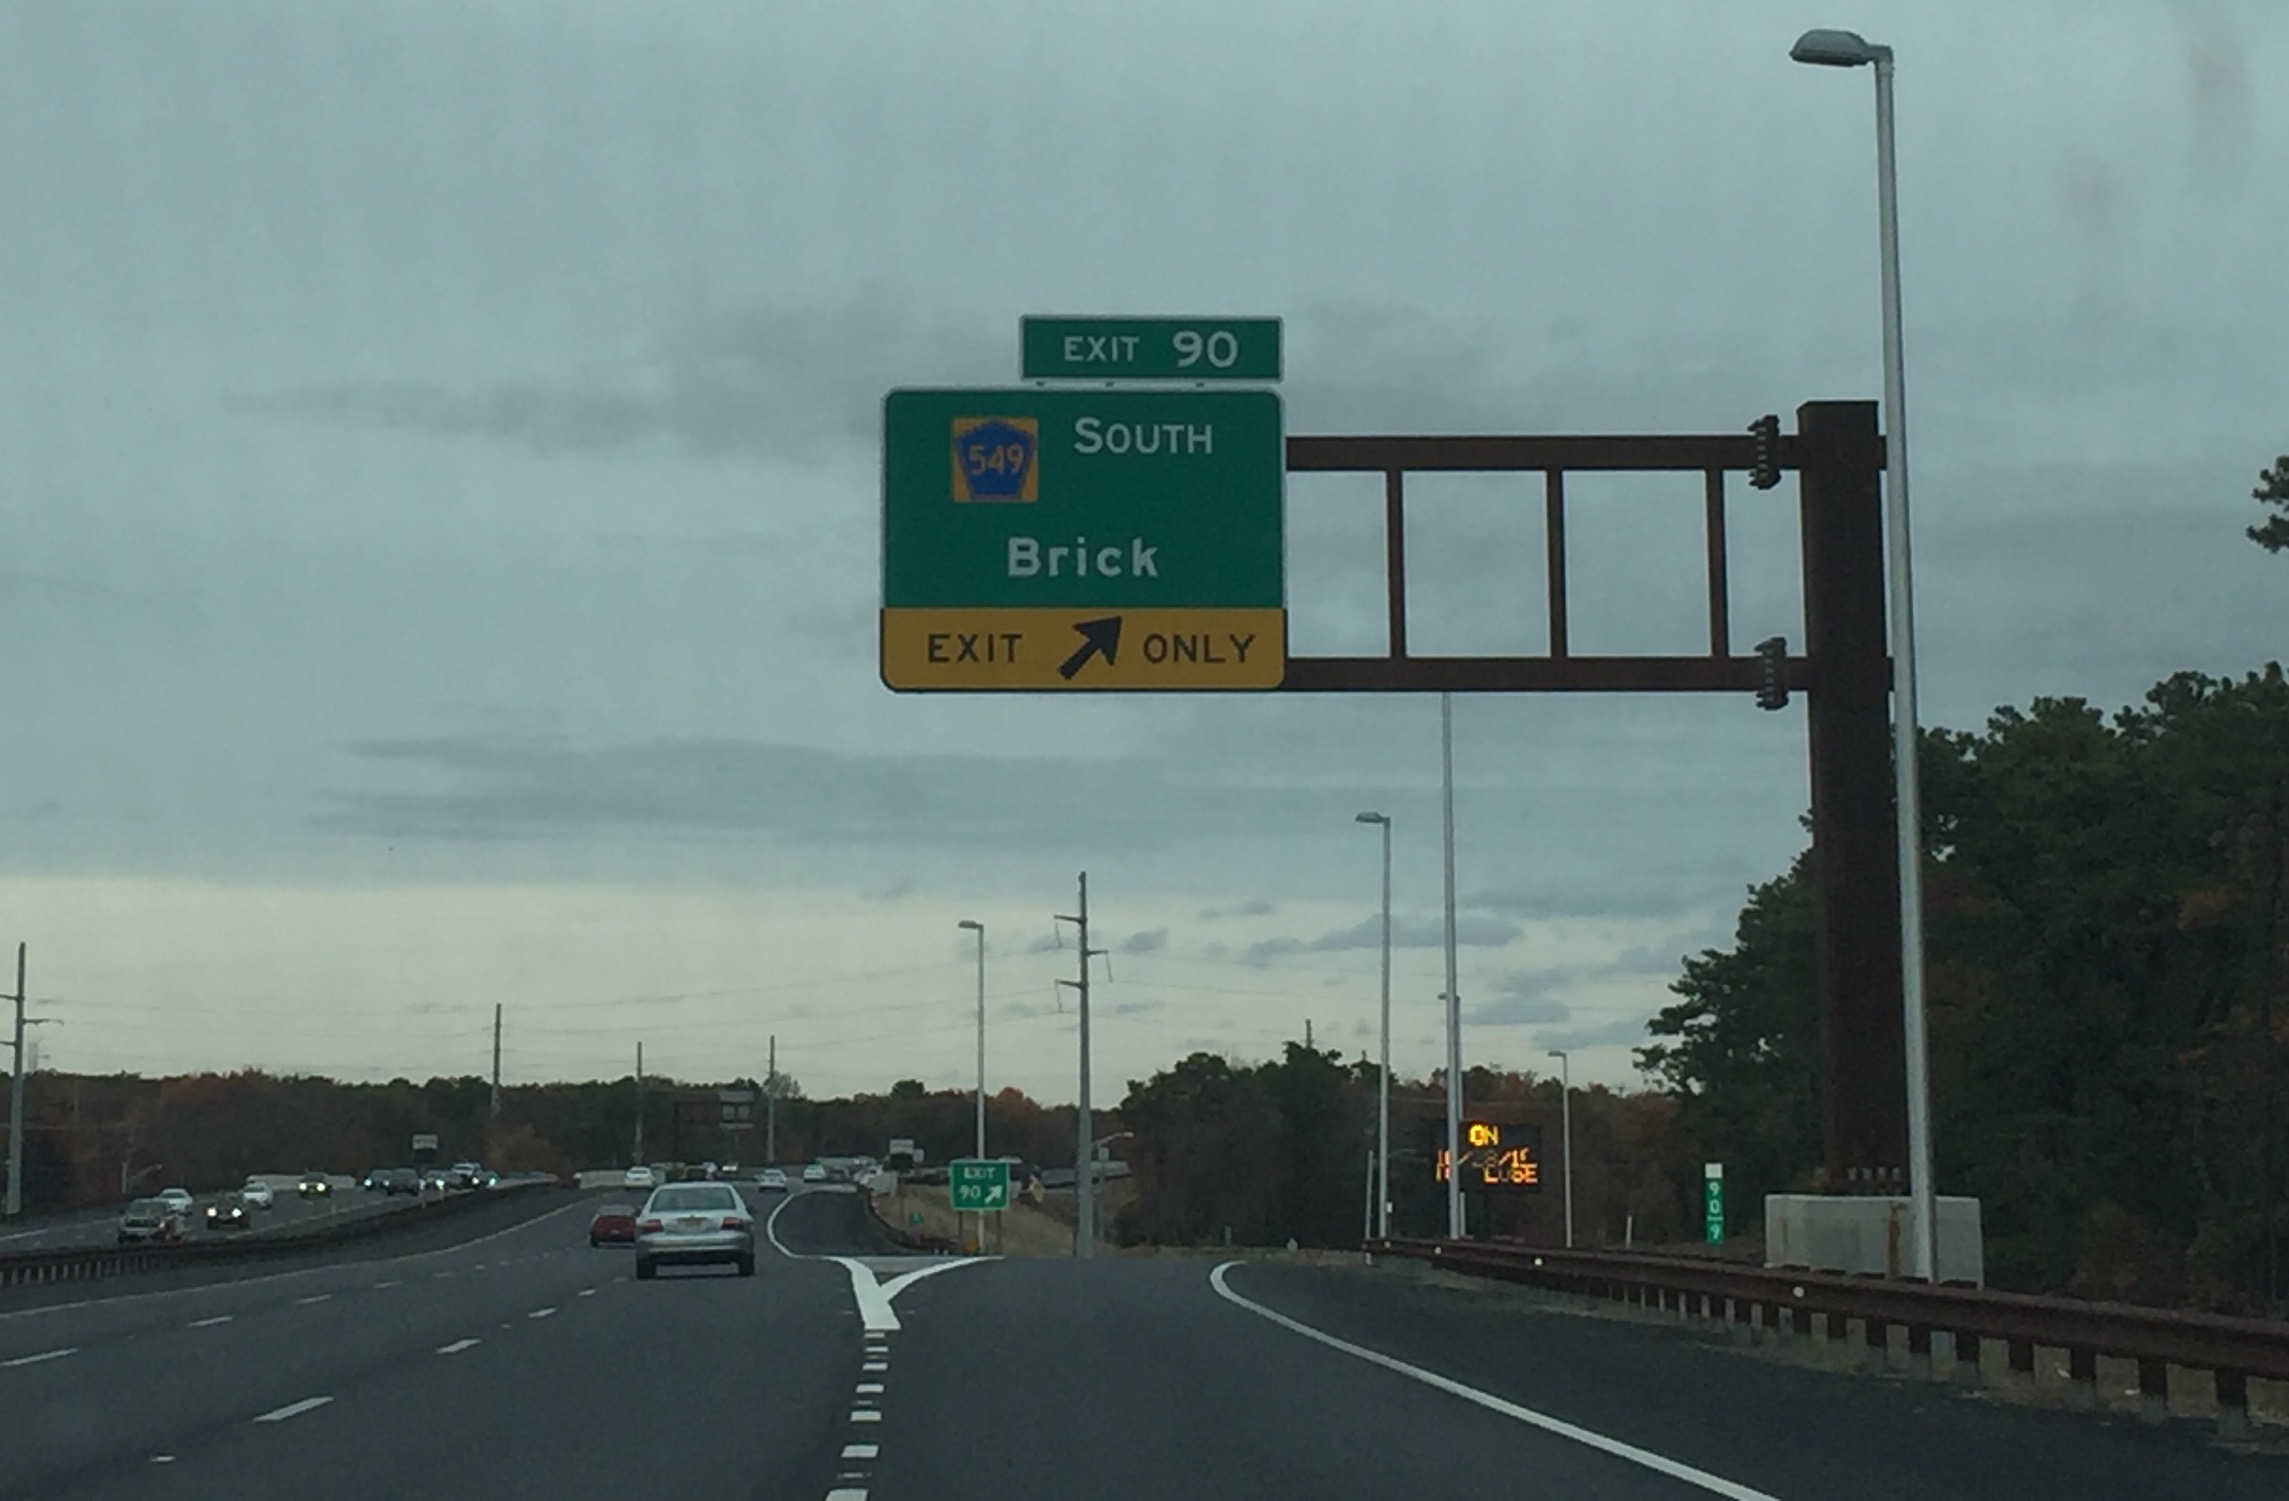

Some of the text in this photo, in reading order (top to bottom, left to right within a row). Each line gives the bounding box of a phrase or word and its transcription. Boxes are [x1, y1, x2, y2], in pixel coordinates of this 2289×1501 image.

[1063, 331, 1239, 367] EXIT 90
[968, 443, 1024, 476] 549
[1007, 537, 1159, 577] Brick
[928, 633, 1255, 664] EXIT ONLY
[1469, 1124, 1498, 1146] ON
[964, 1167, 996, 1178] EXIT
[959, 1184, 981, 1200] 90
